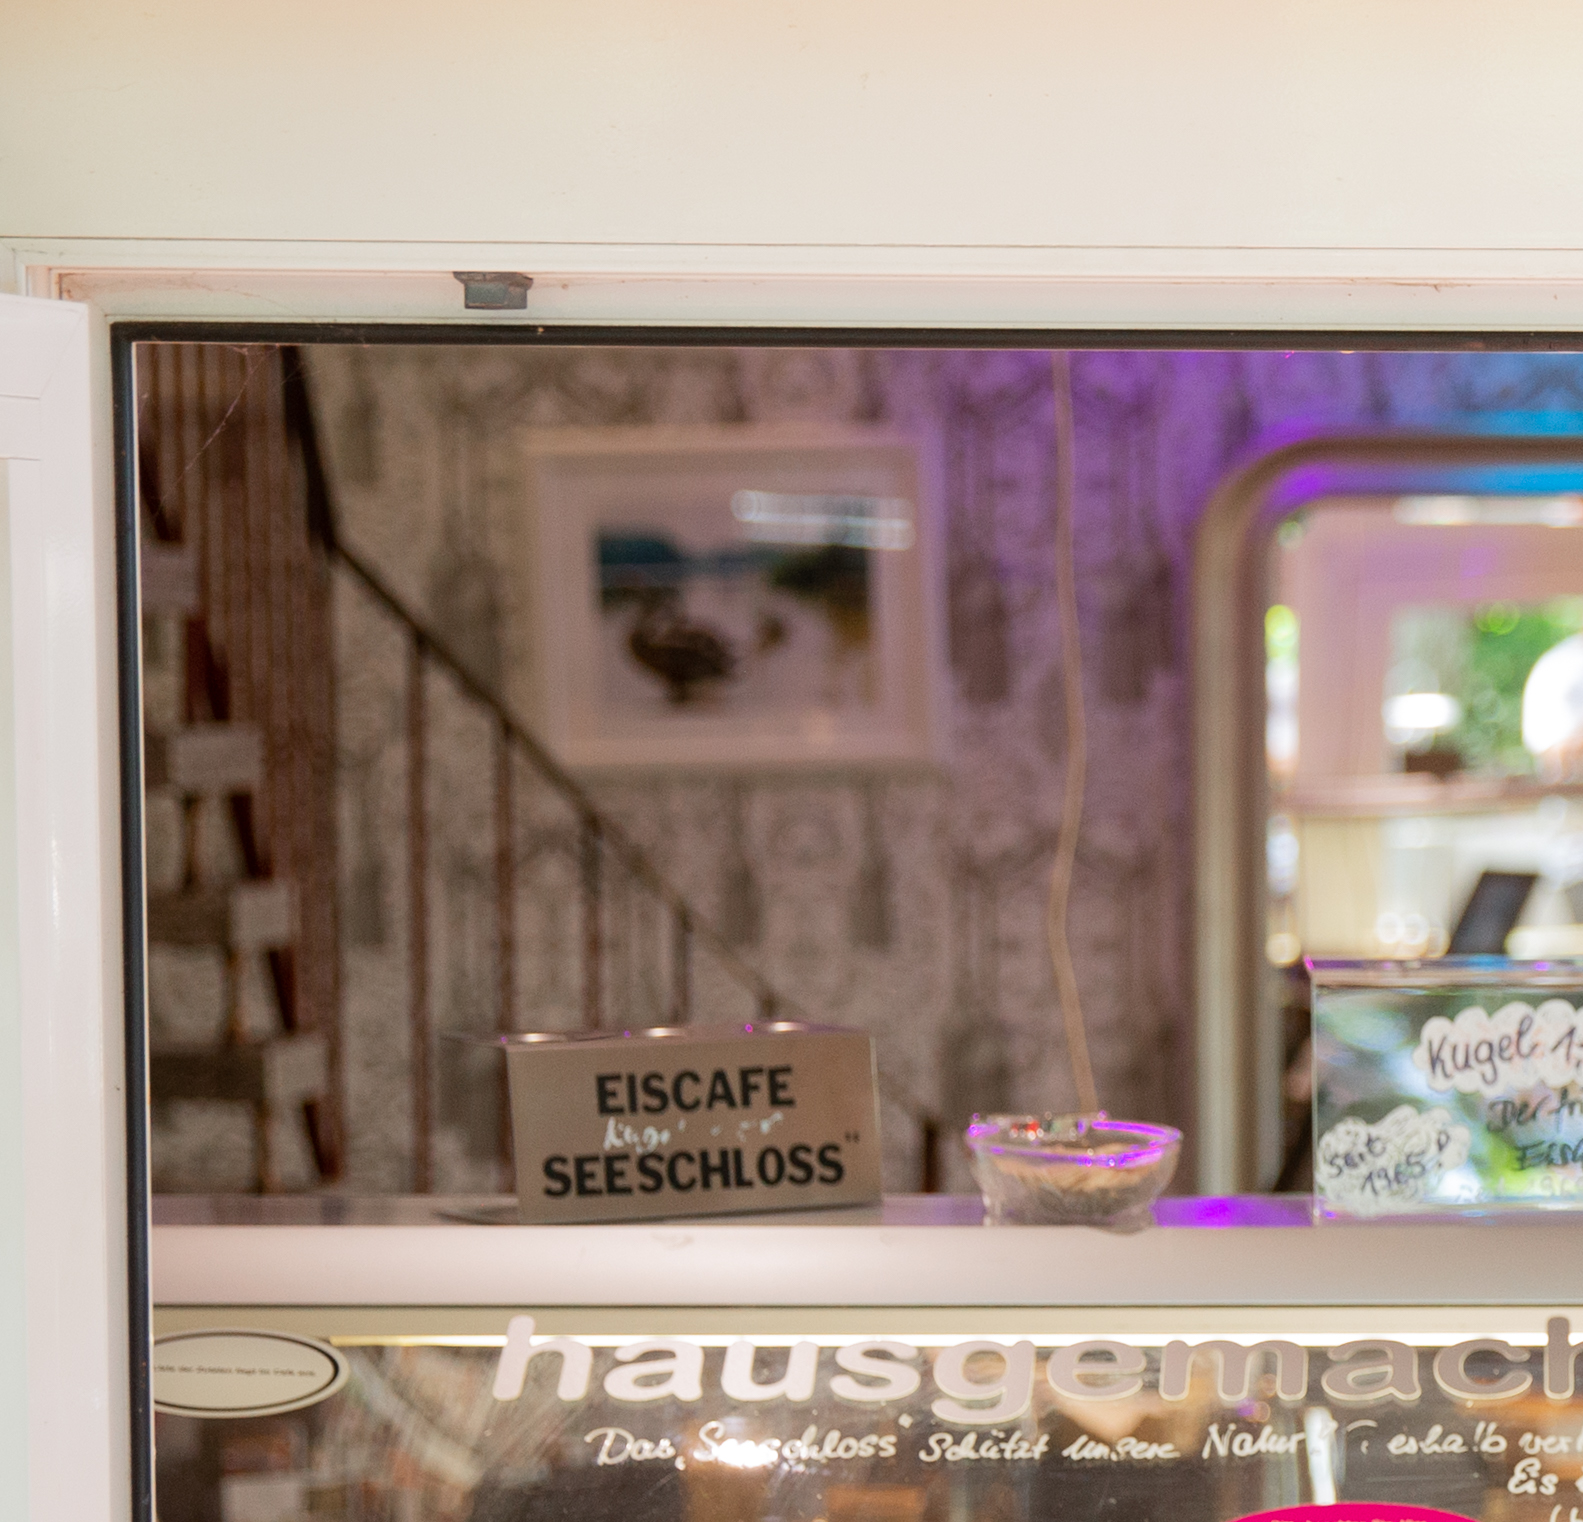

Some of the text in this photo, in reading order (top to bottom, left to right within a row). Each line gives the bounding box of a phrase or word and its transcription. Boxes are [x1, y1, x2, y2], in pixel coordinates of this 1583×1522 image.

[1428, 1016, 1539, 1083] Kugel
[596, 1065, 795, 1116] EISCAFE
[584, 1426, 676, 1466] Das
[1507, 1456, 1559, 1495] Eis
